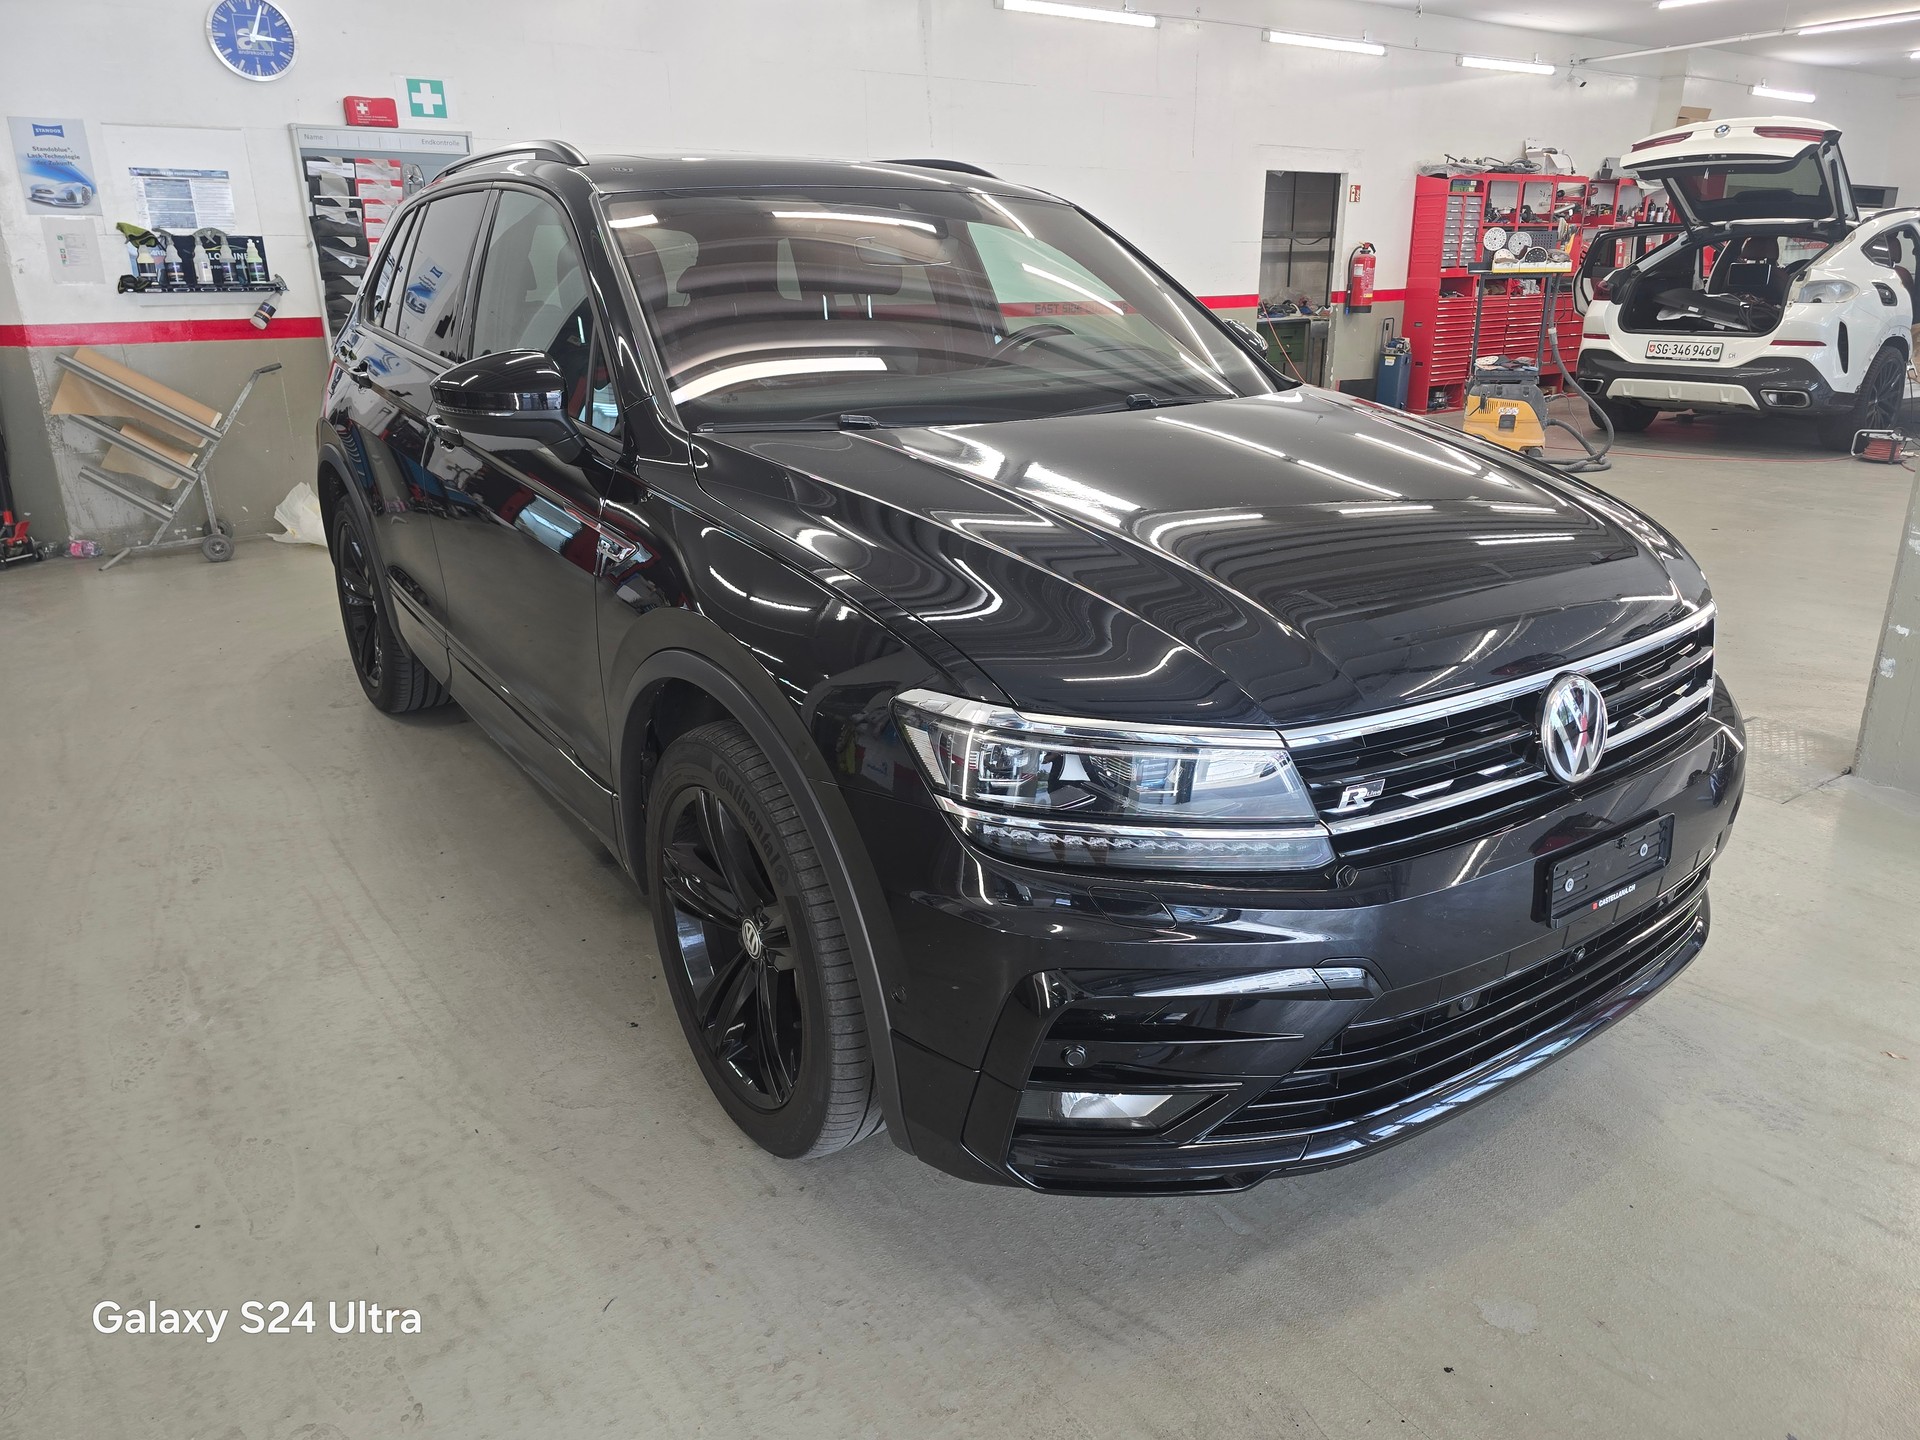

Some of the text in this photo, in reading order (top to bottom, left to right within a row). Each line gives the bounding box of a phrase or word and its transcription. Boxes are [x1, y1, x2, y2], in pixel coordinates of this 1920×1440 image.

[303, 133, 324, 141] Name
[421, 138, 460, 147] Endkontrolle
[26, 152, 81, 160] Lack-Technologie
[1598, 883, 1636, 907] CASTELLANA.CH
